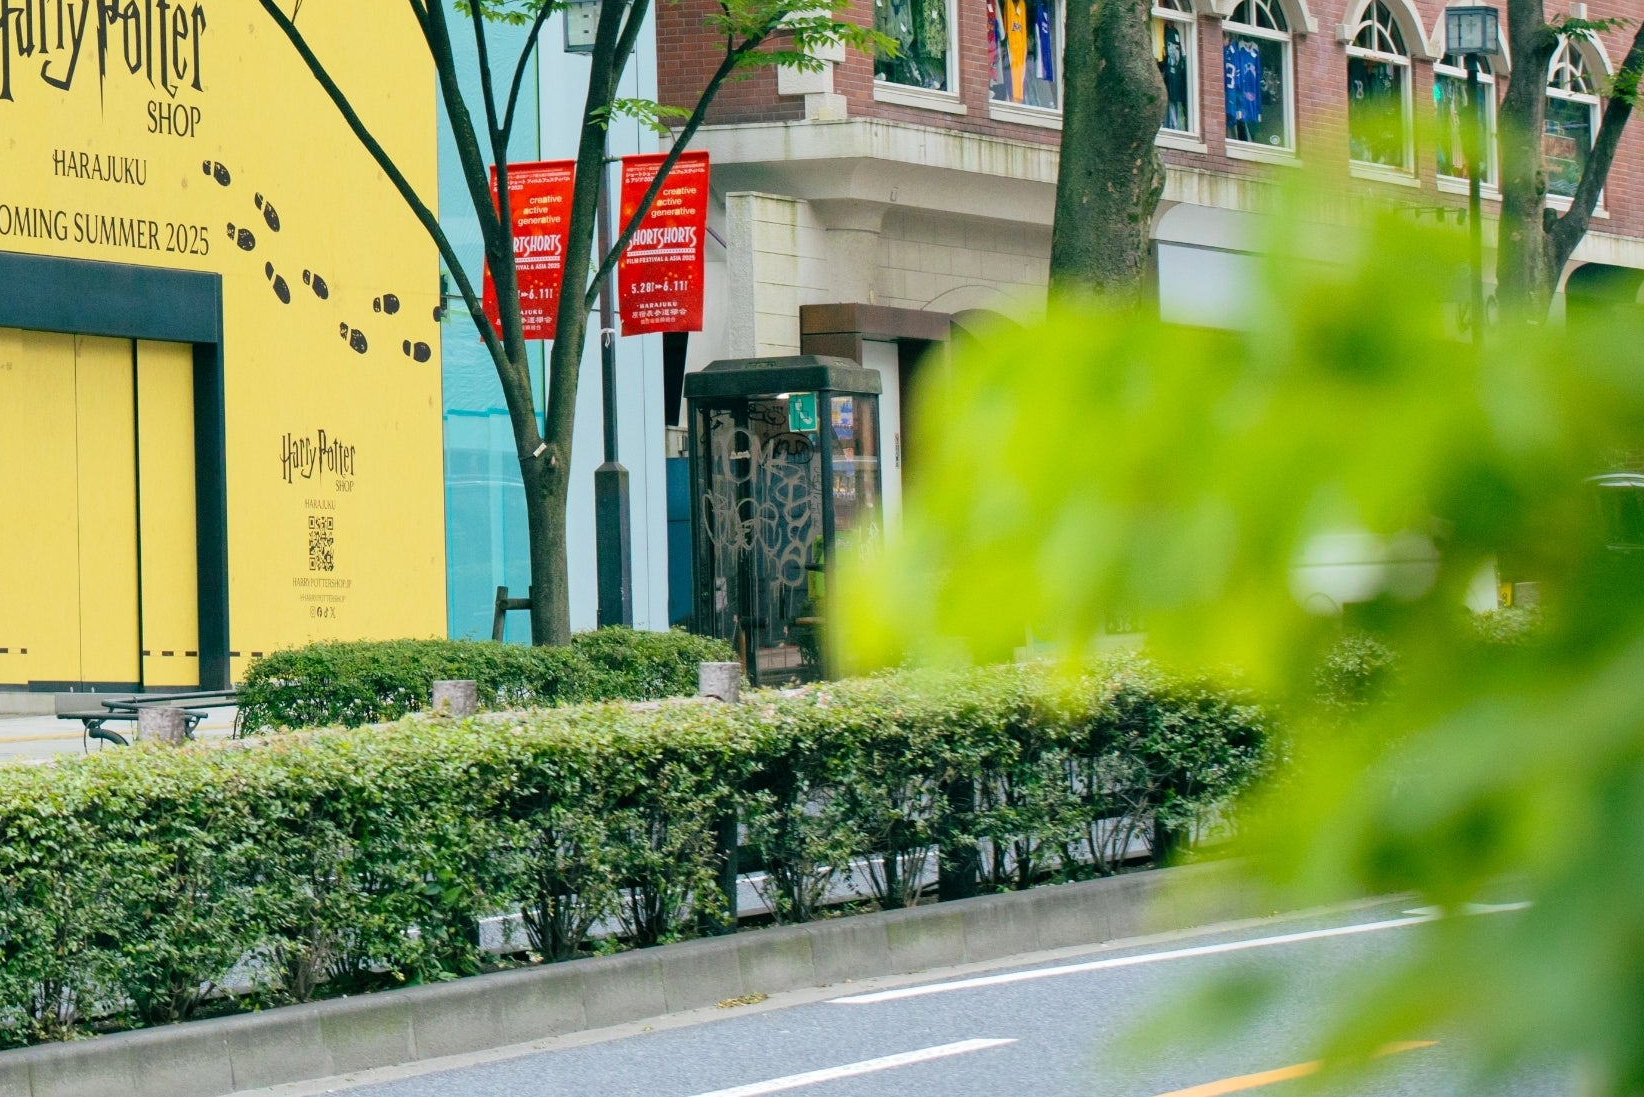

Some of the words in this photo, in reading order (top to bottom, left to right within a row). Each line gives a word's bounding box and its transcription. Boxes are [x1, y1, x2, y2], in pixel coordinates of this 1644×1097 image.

[147, 100, 201, 138] SHOP
[52, 149, 147, 186] HARAJUKU
[662, 187, 697, 196] creative
[529, 195, 563, 205] creative
[656, 198, 683, 207] active
[522, 206, 549, 215] active
[651, 207, 696, 218] generative
[517, 216, 561, 227] generative
[73, 212, 160, 251] SUMMER
[165, 222, 209, 256] 2025
[513, 234, 562, 257] RTSHORTS
[639, 301, 678, 309] HARAJUKU
[279, 433, 317, 484] Harry
[317, 429, 356, 485] Potter
[335, 479, 354, 492] SHOP
[304, 498, 336, 510] HARAJUKU
